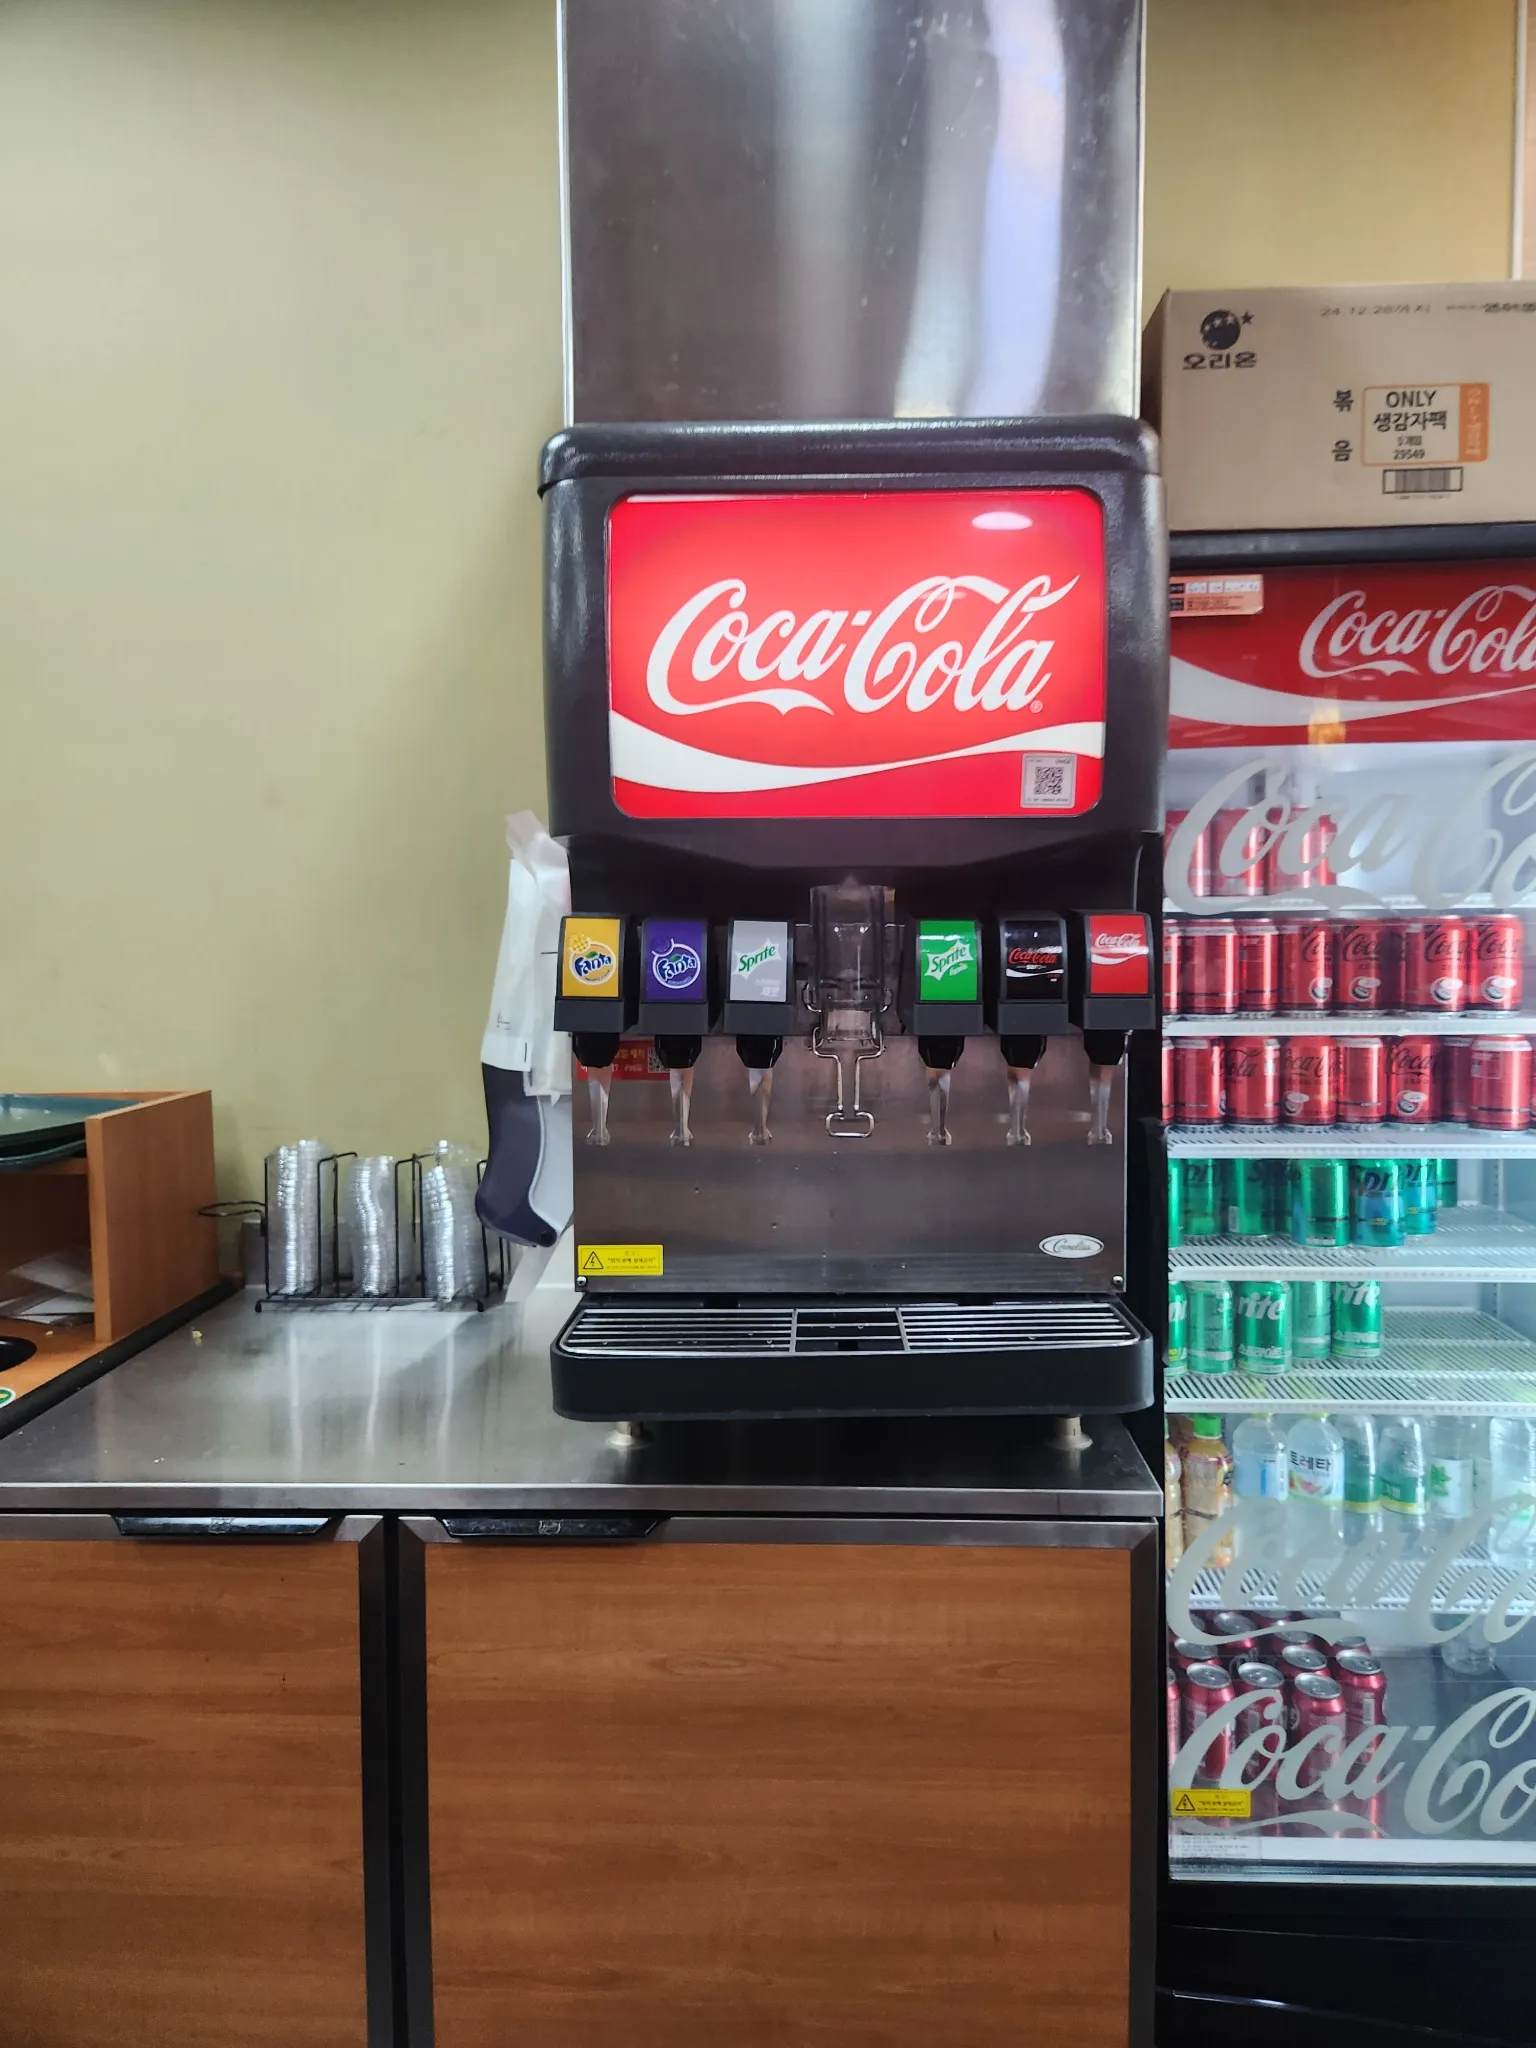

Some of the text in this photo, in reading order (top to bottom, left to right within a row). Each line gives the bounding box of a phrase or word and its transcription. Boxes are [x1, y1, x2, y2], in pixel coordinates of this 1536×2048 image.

[1182, 351, 1257, 371] 오리온
[1385, 390, 1437, 408] ONLY
[646, 574, 1081, 716] Coca-Cola
[1094, 932, 1142, 949] Coca-Cola
[574, 952, 612, 977] Fanta
[657, 953, 697, 982] Fanta
[738, 946, 776, 972] Sprite
[931, 947, 967, 973] Sprite
[1008, 947, 1058, 964] Coca-Cola
